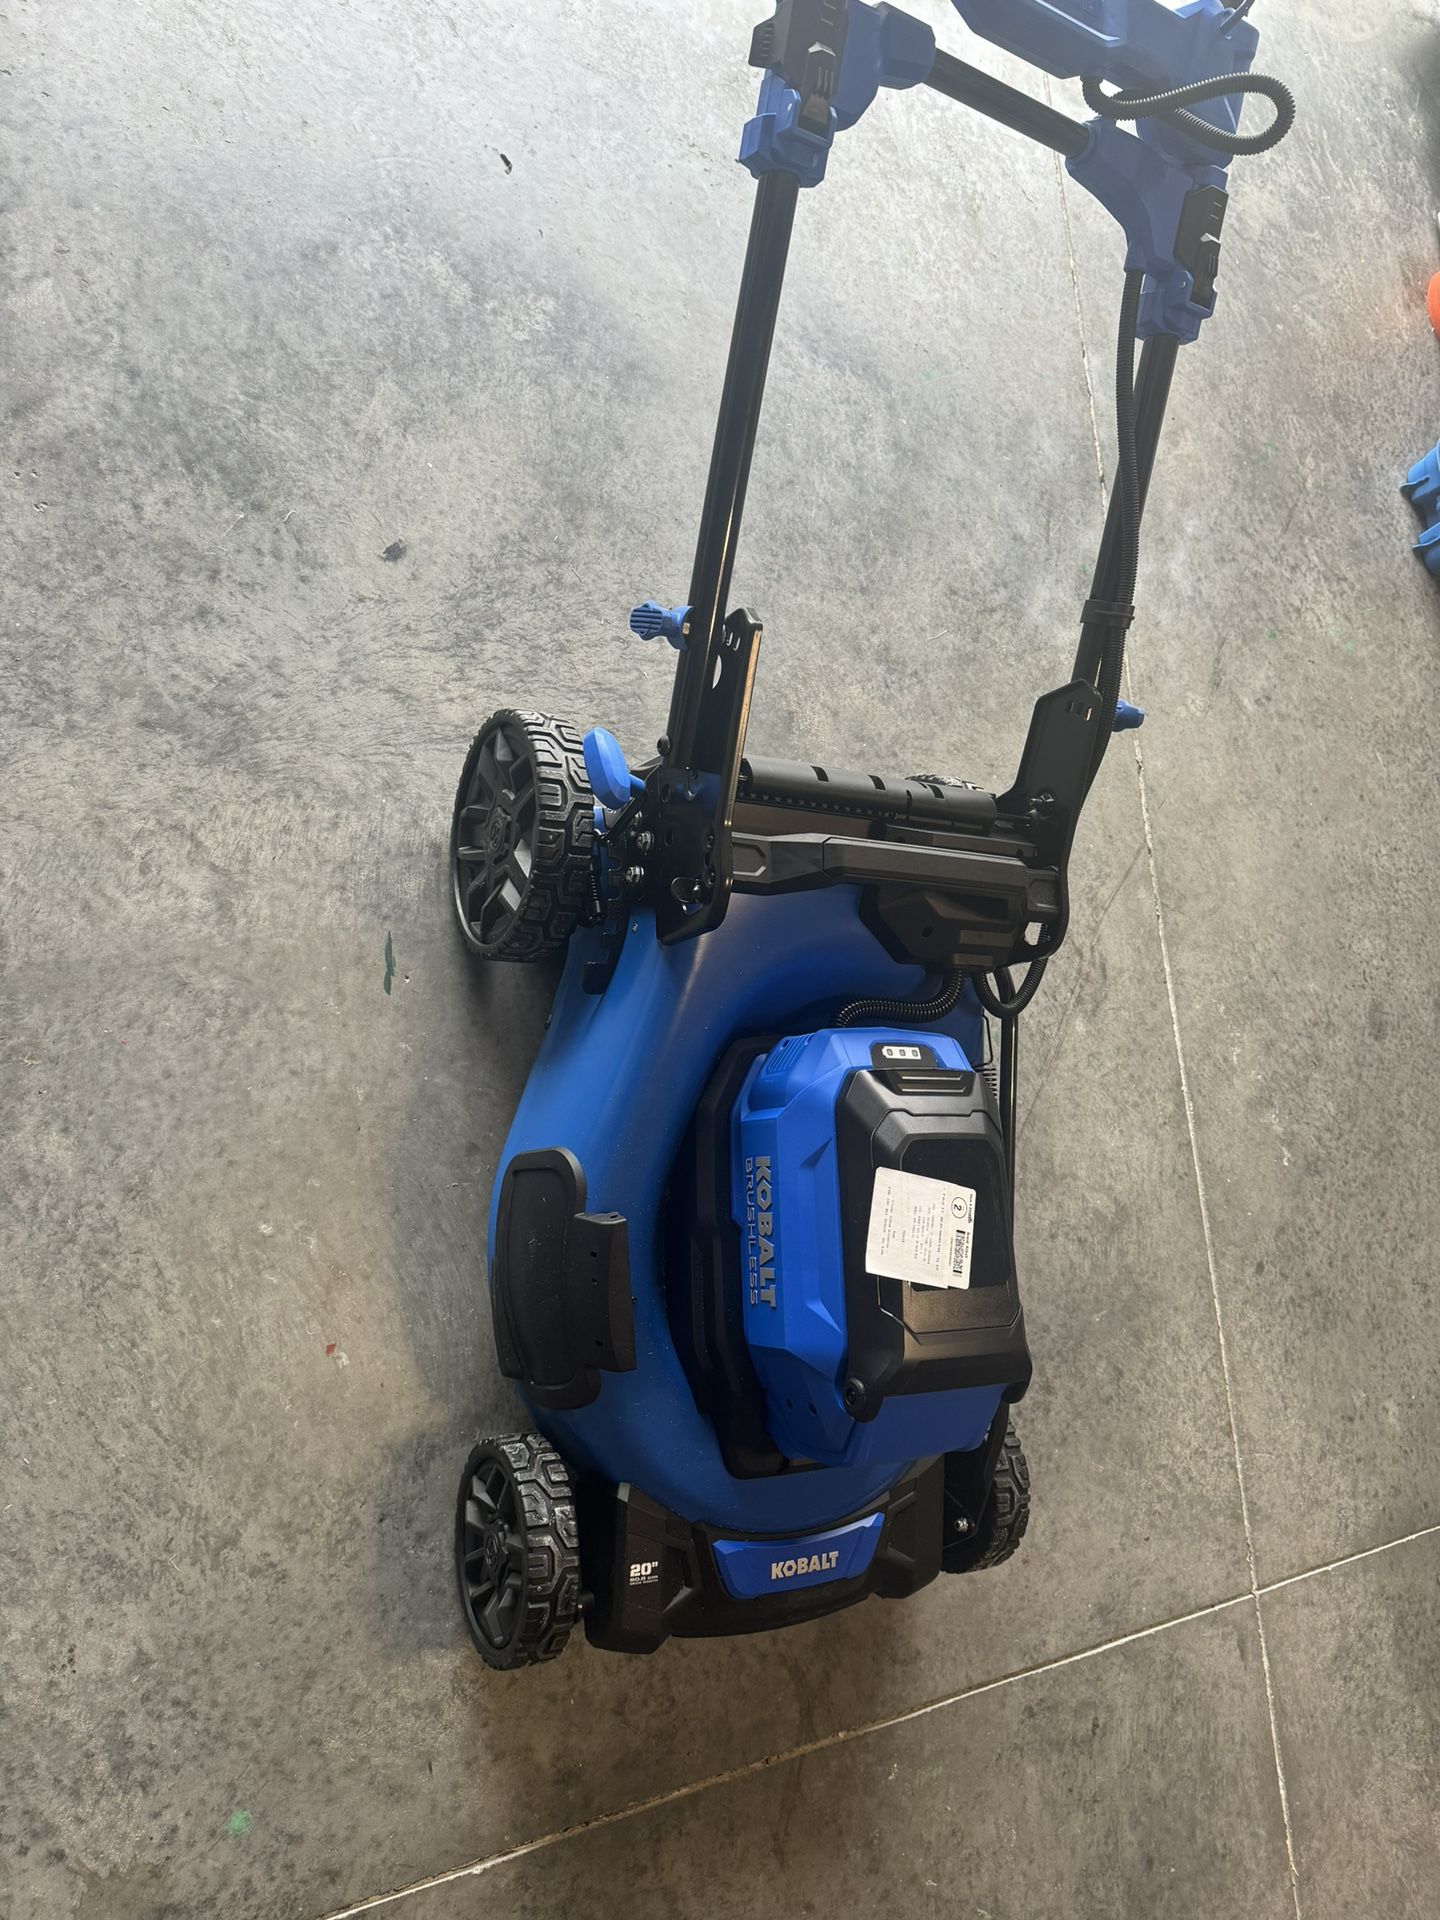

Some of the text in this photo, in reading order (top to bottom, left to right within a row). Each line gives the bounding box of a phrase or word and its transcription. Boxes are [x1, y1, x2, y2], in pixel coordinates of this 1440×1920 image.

[745, 1157, 758, 1305] BRUSHLESS
[755, 1155, 777, 1309] KOBALT
[953, 1203, 962, 1211] 2
[771, 1551, 839, 1580] KOBALT
